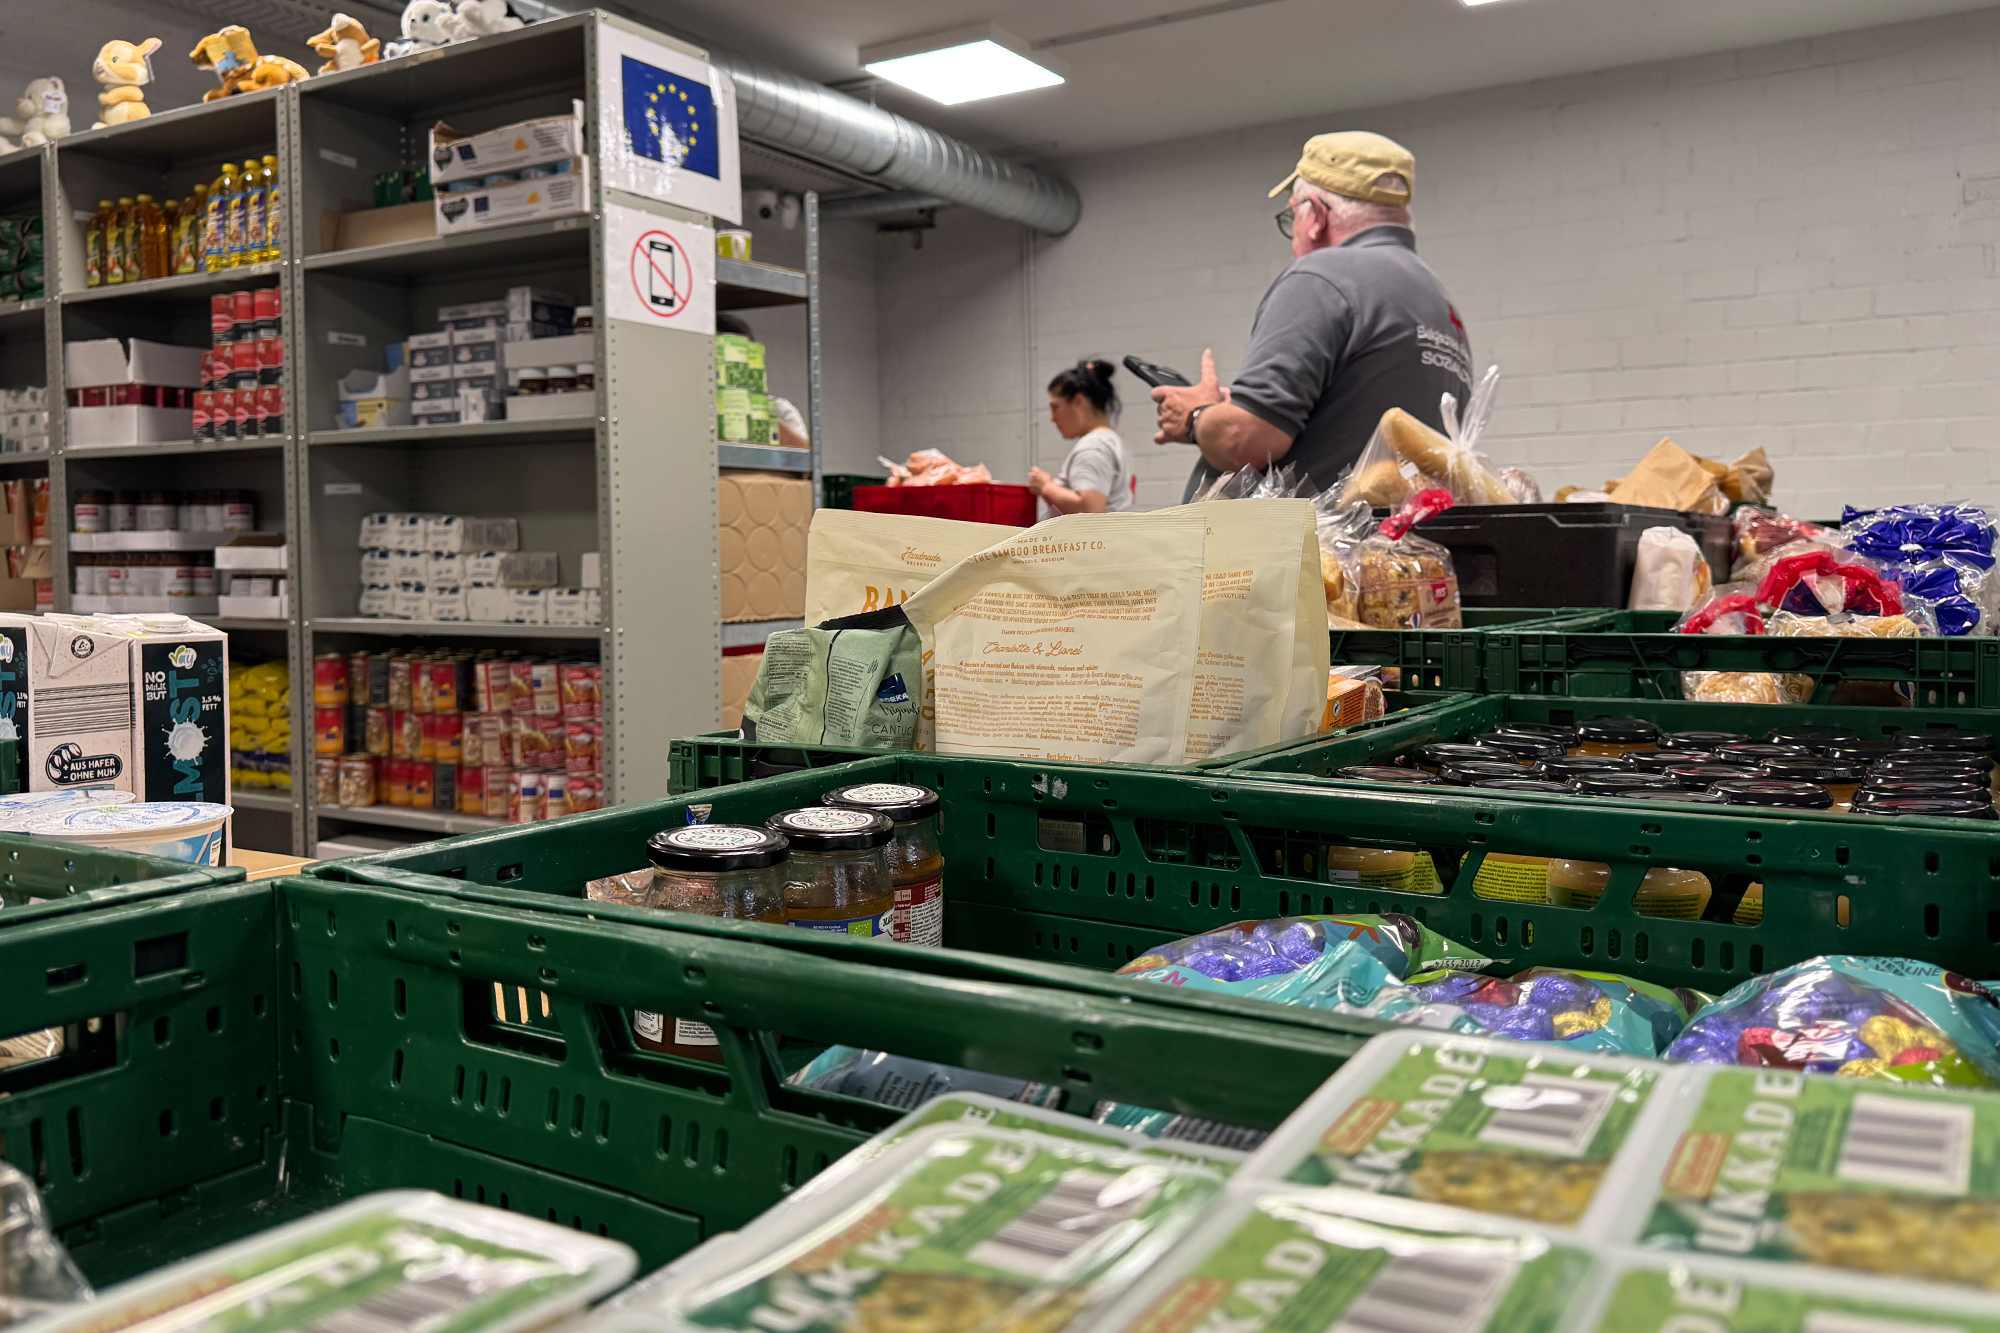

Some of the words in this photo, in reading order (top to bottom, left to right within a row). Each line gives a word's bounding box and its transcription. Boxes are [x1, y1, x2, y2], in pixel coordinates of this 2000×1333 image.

[901, 546, 942, 562] Handmade
[973, 555, 990, 564] THE
[992, 546, 1029, 559] BAMBOO
[1032, 541, 1087, 556] BREAKFAST
[1090, 540, 1106, 550] CO.
[982, 641, 1030, 655] Charlotte
[1032, 642, 1044, 656] &
[1045, 641, 1083, 656] Lionel
[145, 671, 166, 684] NO
[146, 691, 167, 701] BUT
[70, 762, 87, 771] AUS
[88, 758, 115, 768] HAFER
[70, 771, 94, 781] OHNE
[96, 769, 116, 778] MUH
